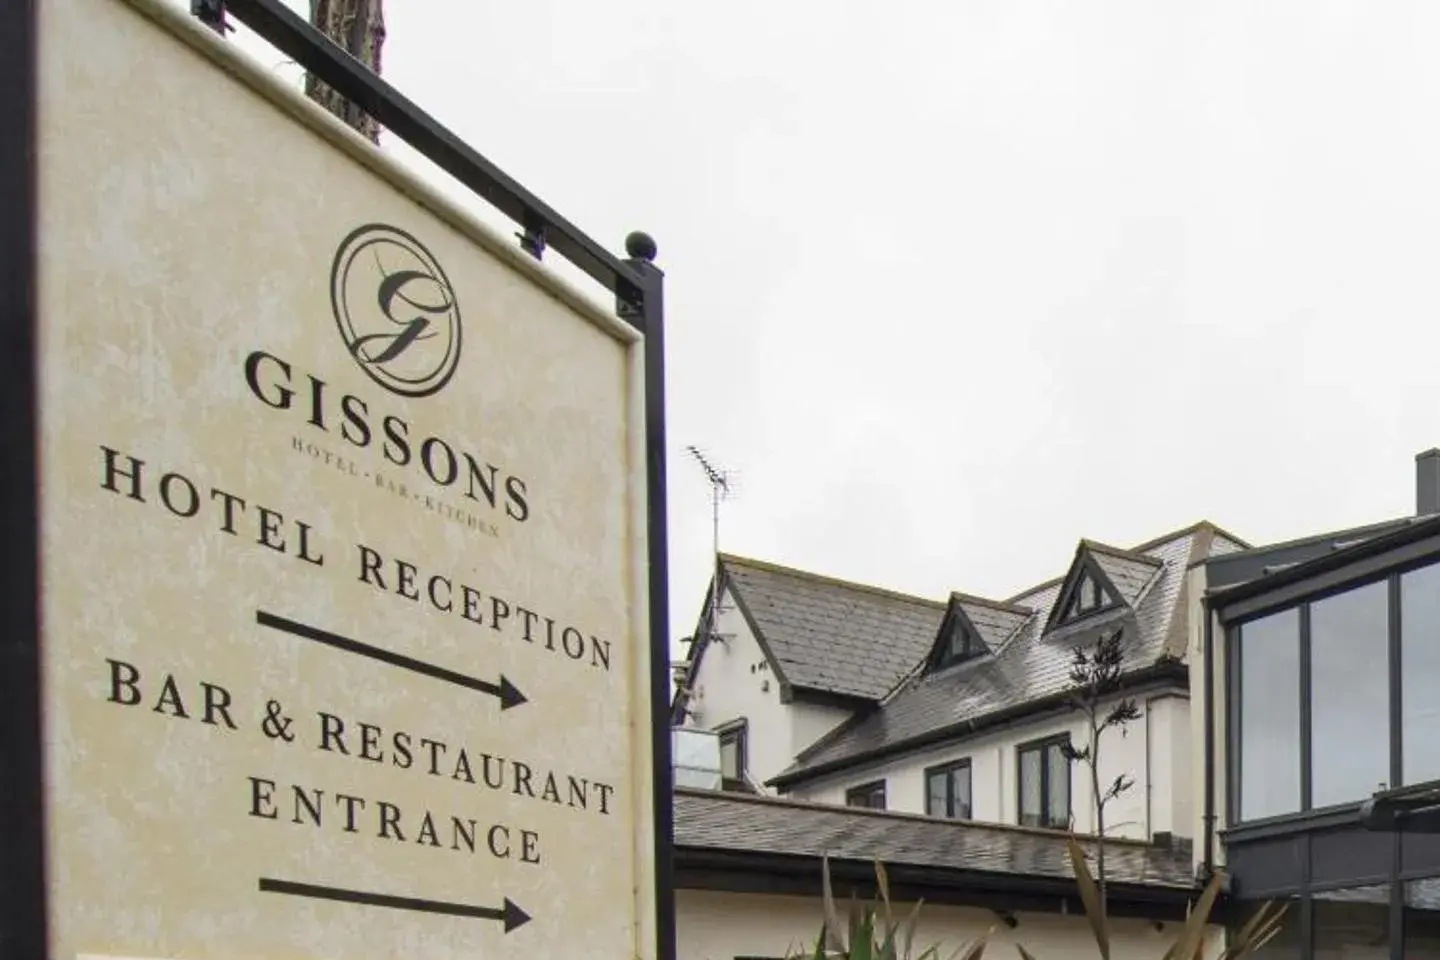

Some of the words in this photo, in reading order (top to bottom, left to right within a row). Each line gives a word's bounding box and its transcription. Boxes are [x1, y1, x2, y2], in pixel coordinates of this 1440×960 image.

[244, 350, 530, 523] GISSONS
[293, 436, 359, 477] HOTEL
[376, 473, 408, 499] BAR
[425, 494, 499, 538] KITCHEN
[99, 446, 324, 566] HOTEL
[357, 544, 612, 671] RECEPTION
[105, 658, 238, 729] BAR
[261, 699, 296, 743] &
[318, 712, 614, 815] RESTAURANT
[248, 776, 542, 865] ENTRANCE
